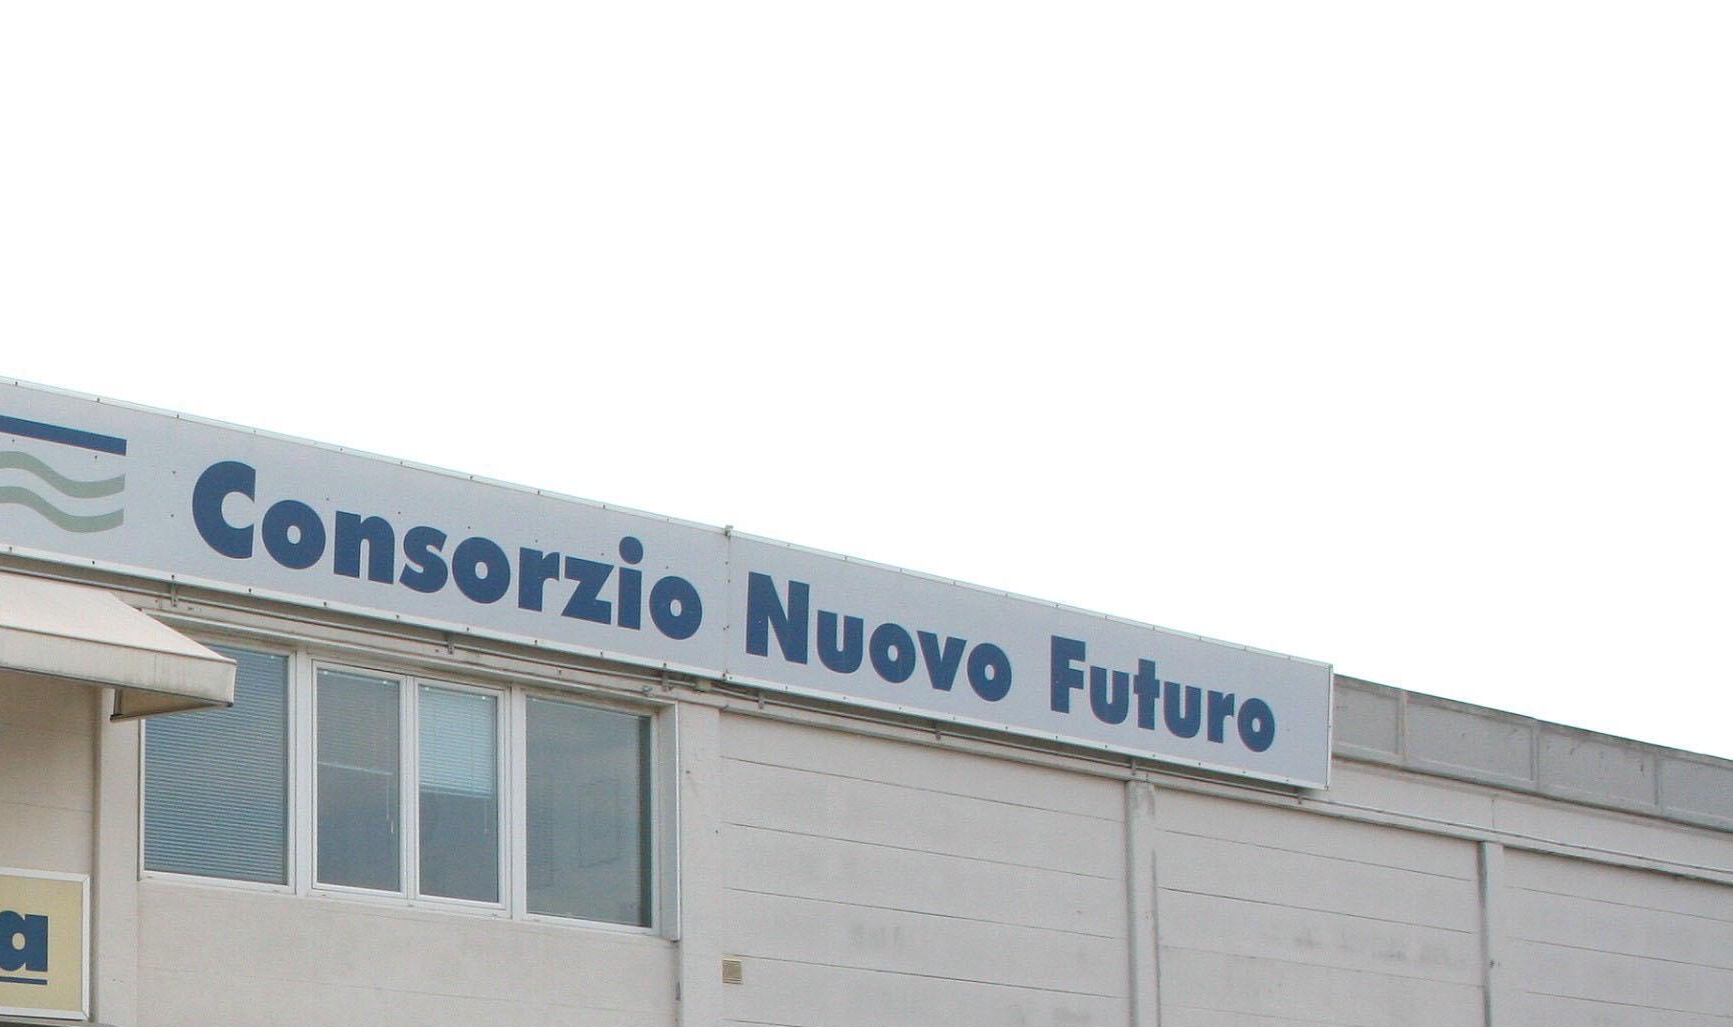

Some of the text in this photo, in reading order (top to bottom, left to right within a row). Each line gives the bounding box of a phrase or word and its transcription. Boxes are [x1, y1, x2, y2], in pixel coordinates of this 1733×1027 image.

[192, 460, 1276, 753] Consorzio Nuovo Futuro
